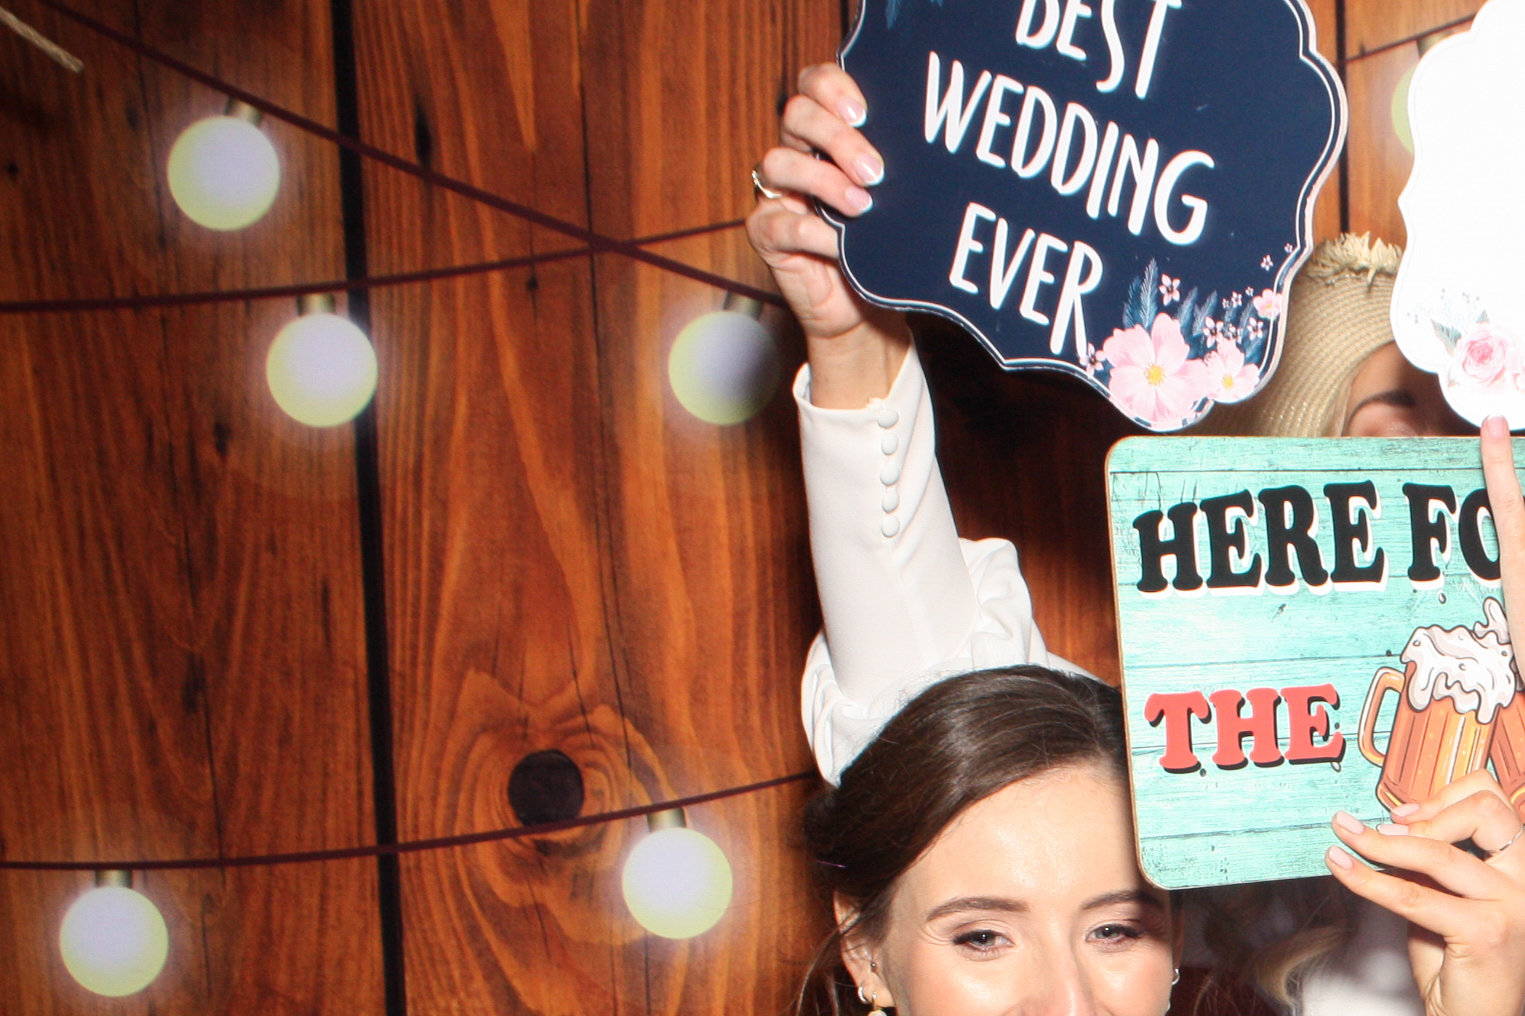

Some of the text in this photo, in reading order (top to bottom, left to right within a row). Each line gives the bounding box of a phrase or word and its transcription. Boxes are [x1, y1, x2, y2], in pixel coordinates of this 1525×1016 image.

[925, 51, 1215, 245] WEDDING
[949, 202, 1103, 358] EVER
[1133, 480, 1387, 597] HERE
[1144, 683, 1346, 774] THE
